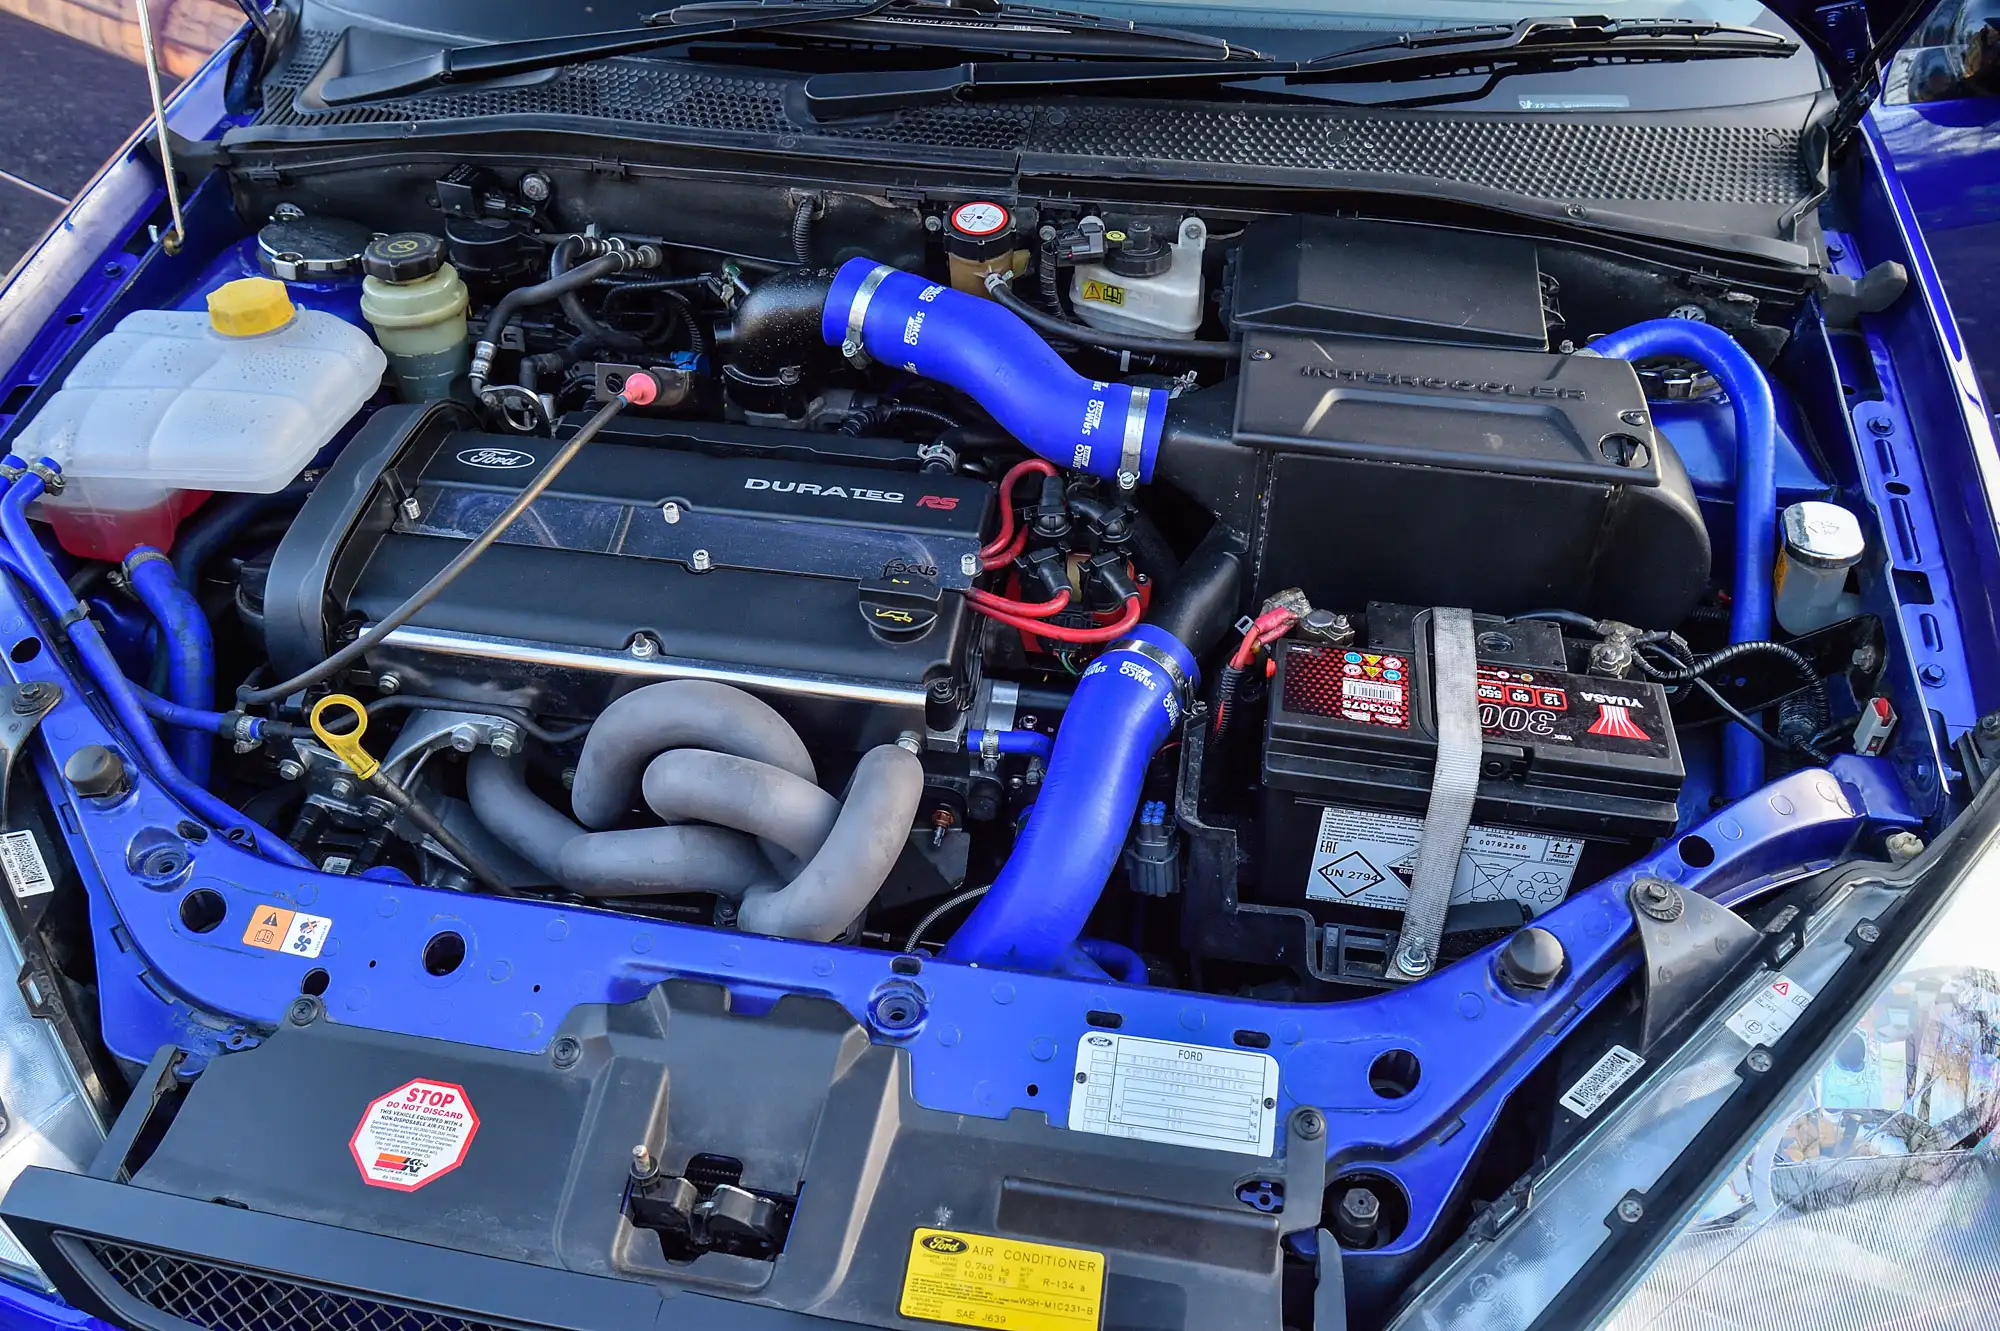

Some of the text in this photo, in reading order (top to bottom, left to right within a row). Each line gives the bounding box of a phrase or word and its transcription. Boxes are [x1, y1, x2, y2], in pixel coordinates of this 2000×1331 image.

[910, 311, 926, 346] SAMCO
[1301, 365, 1587, 400] INTERCOOLER
[1082, 399, 1097, 436] SAMCO
[744, 478, 960, 510] DURATEC RS
[1120, 667, 1156, 690] SAMCO
[1478, 688, 1502, 698] 550
[1512, 693, 1529, 702] 60
[1580, 691, 1644, 708] YUASA
[1342, 700, 1402, 715] YBX3075
[1544, 696, 1560, 706] 12
[1325, 867, 1378, 882] UN 2794
[1178, 1050, 1203, 1061] FORD
[406, 1088, 455, 1108] STOP
[386, 1100, 463, 1119] DO NOT DISCARD
[416, 1114, 442, 1123] EQUIPPED
[930, 1236, 961, 1252] Ford
[972, 1246, 1096, 1272] AIR CONDITIONER
[1000, 1266, 1010, 1276] kg
[1042, 1278, 1074, 1290] R-134
[956, 1309, 976, 1320] SAE
[982, 1312, 1007, 1324] J639
